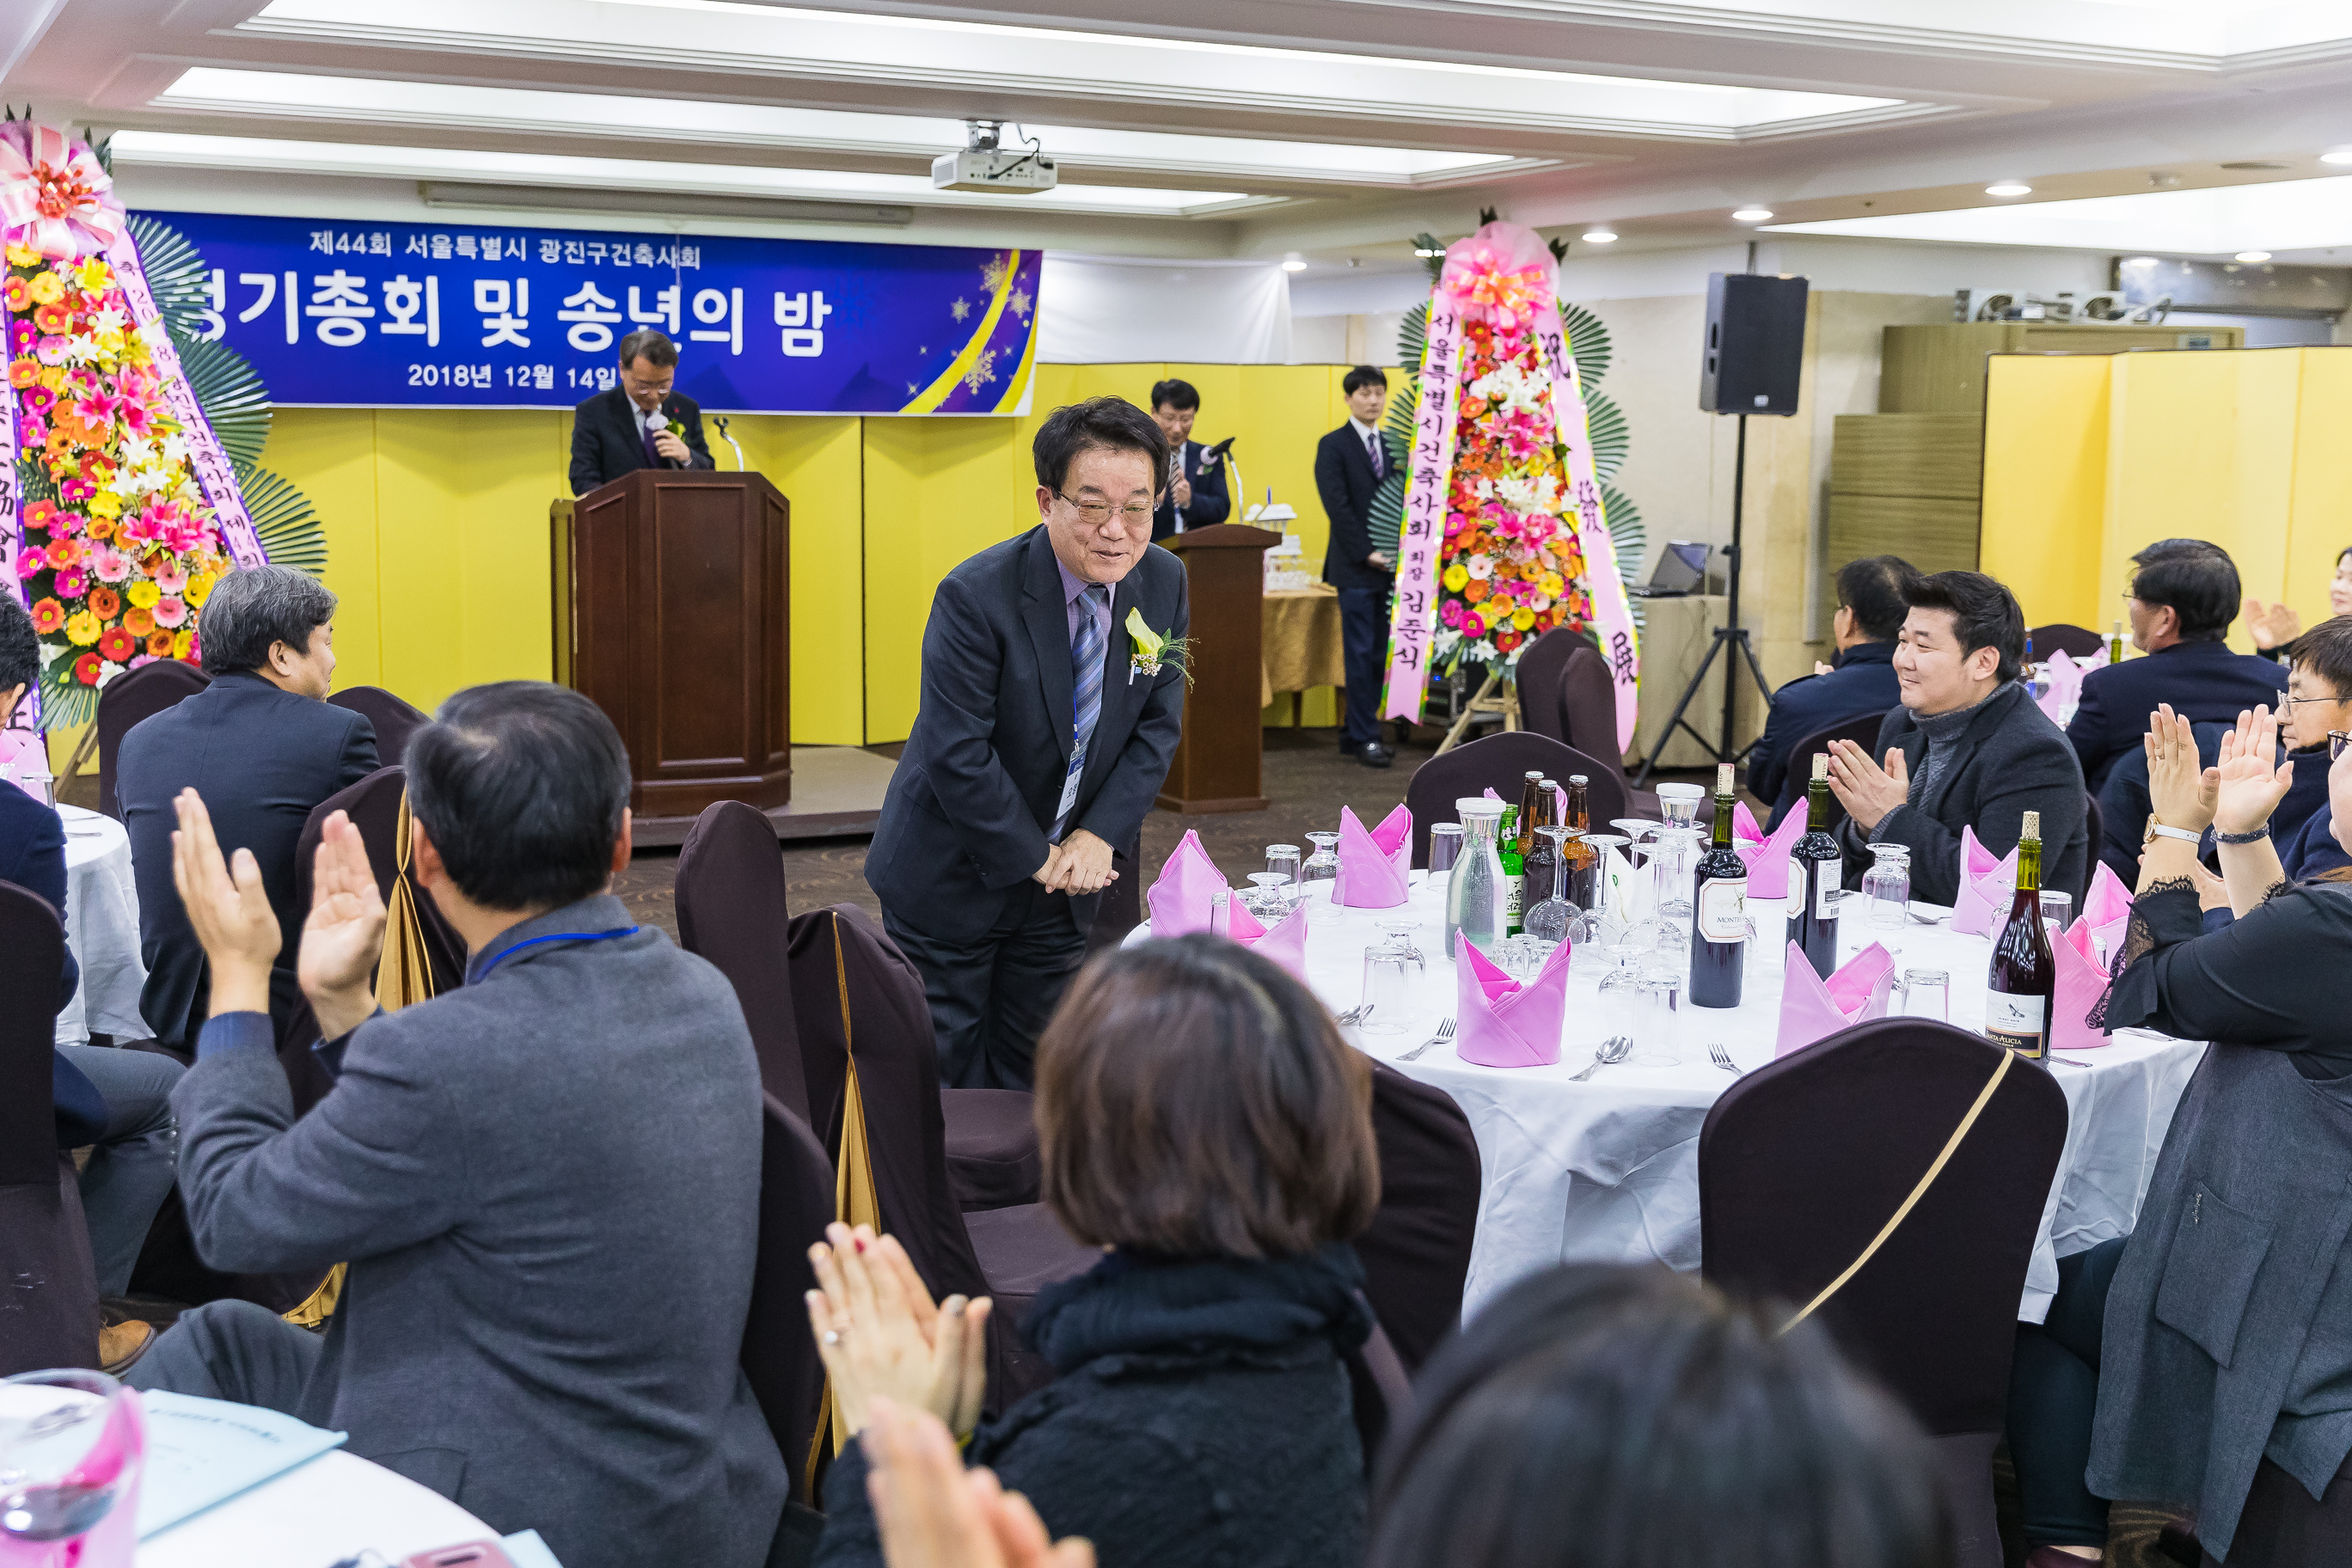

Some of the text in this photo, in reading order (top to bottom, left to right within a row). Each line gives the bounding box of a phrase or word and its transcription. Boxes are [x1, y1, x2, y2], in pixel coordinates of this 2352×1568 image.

[309, 230, 701, 270] 제44회 서울특별시 광진구건축사회
[474, 277, 532, 348] 및
[557, 280, 744, 356] 송년의
[774, 289, 832, 358] 밤
[407, 363, 616, 392] 2018년 12월 14일
